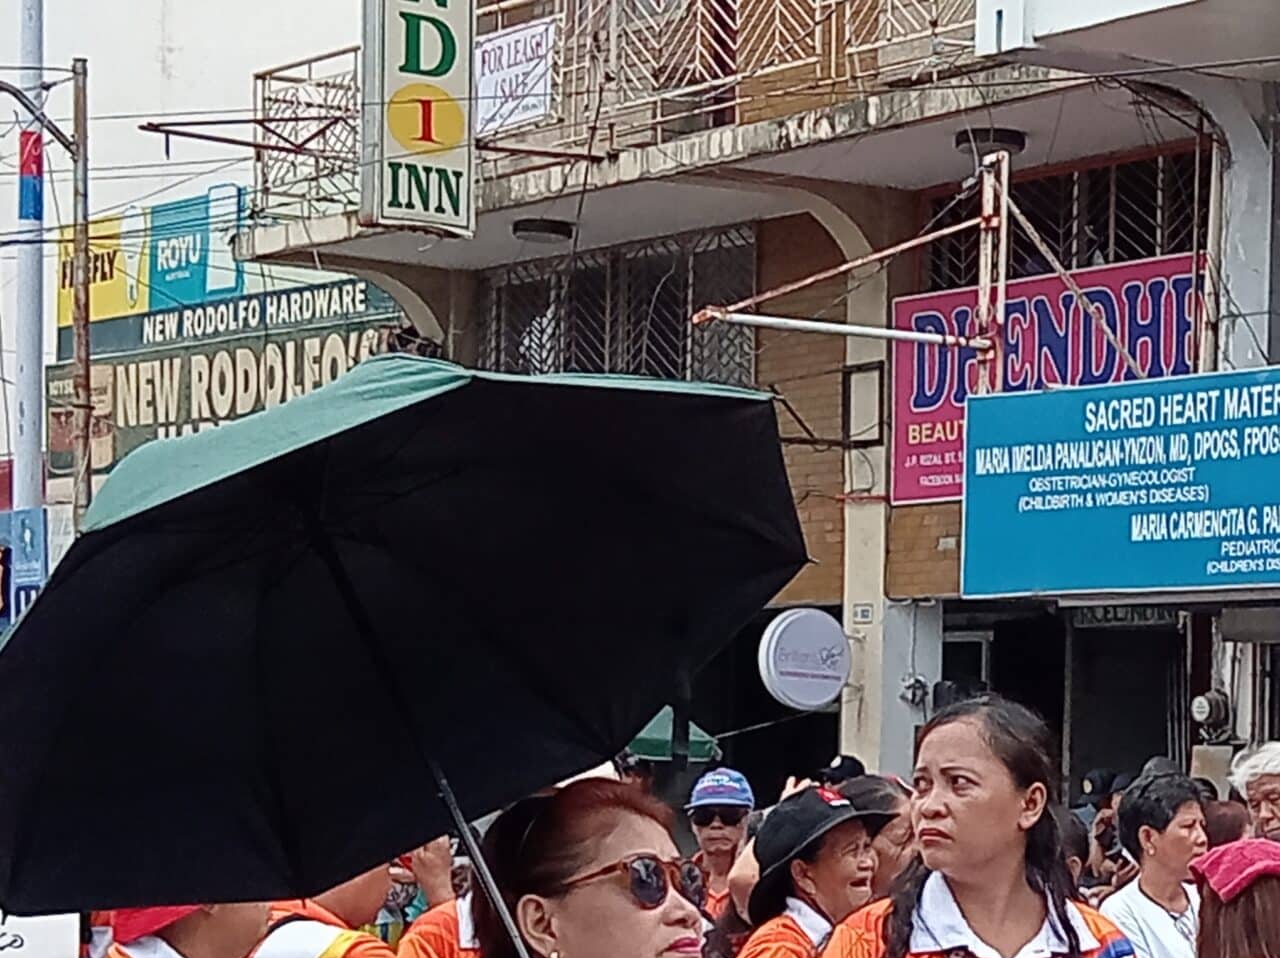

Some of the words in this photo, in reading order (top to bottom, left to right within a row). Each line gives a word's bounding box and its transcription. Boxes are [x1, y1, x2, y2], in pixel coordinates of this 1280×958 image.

[482, 46, 504, 76] FOR
[388, 162, 463, 216] INN
[61, 250, 117, 289] FIFLY
[157, 234, 201, 271] ROYU
[143, 315, 178, 344] NEW
[182, 300, 259, 338] RODOLFO
[265, 283, 367, 325] HARDWARE
[115, 357, 183, 428] NEW
[1085, 398, 1155, 433] SACRED
[1160, 391, 1219, 426] HEART
[975, 446, 1011, 475] MARIA
[1012, 444, 1052, 473] IMELDA
[1169, 434, 1191, 466] MD,
[1194, 429, 1240, 461] DPOGS,
[1018, 494, 1084, 512] (CHILDBIRTH
[1086, 493, 1093, 507] &
[1096, 488, 1147, 506] WOMEN'S
[1149, 485, 1209, 504] DISEASES)
[1131, 512, 1171, 541] MARIA
[1170, 508, 1245, 540] CARMENCITA
[1247, 508, 1261, 536] G.
[1207, 558, 1265, 575] (CHILDREN'S
